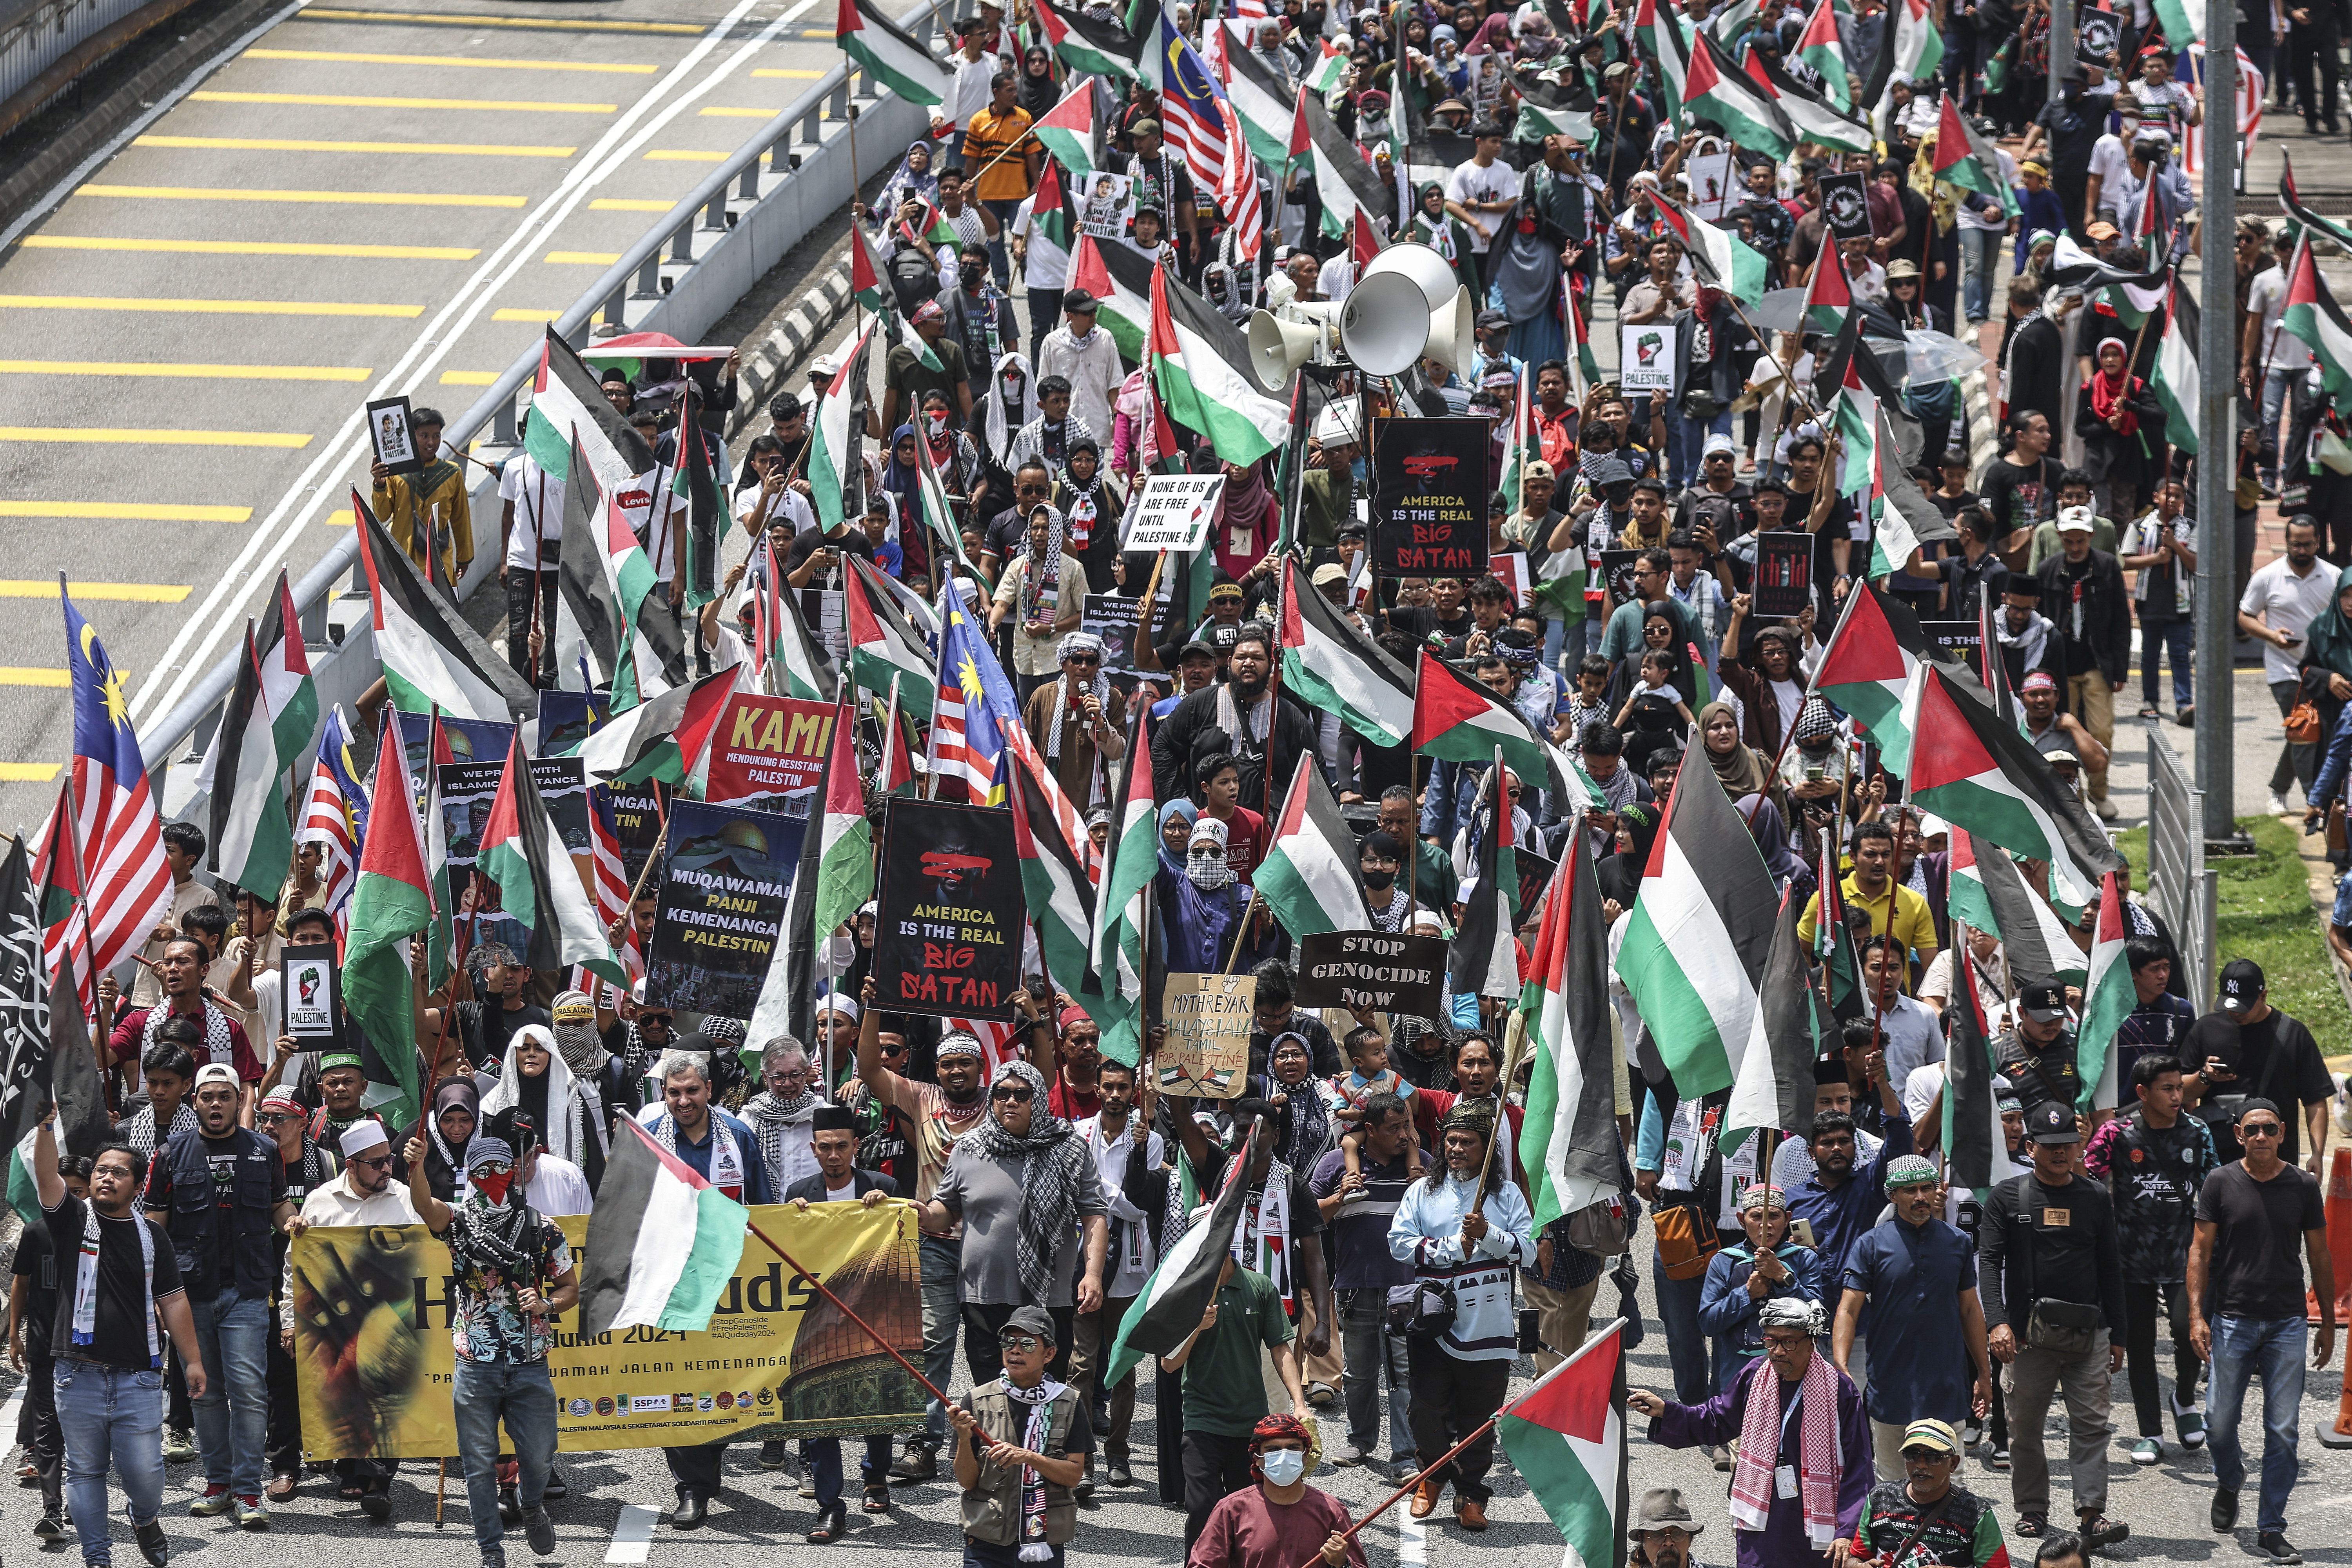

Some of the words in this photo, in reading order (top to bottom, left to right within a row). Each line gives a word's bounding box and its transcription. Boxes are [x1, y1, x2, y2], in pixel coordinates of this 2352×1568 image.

[1625, 373, 1670, 385] PALESTINE
[1151, 481, 1176, 493] NONE
[1178, 481, 1189, 493] OF
[1191, 481, 1205, 492] US
[1144, 498, 1162, 509] ARE
[1165, 498, 1188, 509] FREE
[1401, 496, 1466, 506] AMERICA
[1139, 515, 1164, 526] UNTIL
[1392, 509, 1406, 520] IS
[1409, 509, 1436, 521] THE
[1440, 510, 1474, 521] REAL
[1132, 531, 1181, 543] PALESTINE
[1397, 548, 1472, 568] SATAN
[1610, 567, 1621, 586] PEACE
[1621, 563, 1634, 572] AND
[1090, 609, 1129, 618] ISLAMIC
[1938, 636, 1953, 645] IS
[1954, 636, 1982, 645] THE
[726, 752, 777, 769] MENDUKUNG
[532, 766, 561, 774] WITH
[748, 769, 803, 787] PALESTIN
[789, 802, 805, 814] NOT
[706, 895, 758, 913] PANJI
[666, 907, 779, 937] KEMENANGA
[912, 904, 996, 925] AMERICA
[900, 920, 918, 936] IS
[924, 924, 956, 940] THE
[961, 928, 1005, 945] REAL
[683, 929, 771, 955] PALESTIN
[1343, 937, 1406, 956] STOP
[1312, 962, 1432, 985] GENOCIDE
[901, 971, 998, 1008] SATAN
[1200, 976, 1210, 992] I
[1172, 994, 1250, 1014] MYTHREYAR
[1342, 987, 1395, 1007] NOW
[2046, 989, 2059, 1005] LA
[291, 1012, 328, 1024] PALESTINE
[1166, 1018, 1250, 1038] MALAYSIAN
[1185, 1038, 1221, 1051] TAMIL
[1158, 1052, 1177, 1065] FOR
[1178, 1052, 1244, 1067] PALESTINE
[711, 1316, 768, 1326] #StopGenoside
[711, 1323, 767, 1332] #FreePalestine
[622, 1324, 687, 1344] 2024
[711, 1330, 776, 1339] #AlQudsday2024
[621, 1361, 673, 1374] JALAN
[673, 1392, 693, 1407] BDS
[588, 1424, 621, 1432] MALAYSIA
[628, 1421, 671, 1430] SEKRETARIAT
[671, 1419, 706, 1427] SOLIDARITI
